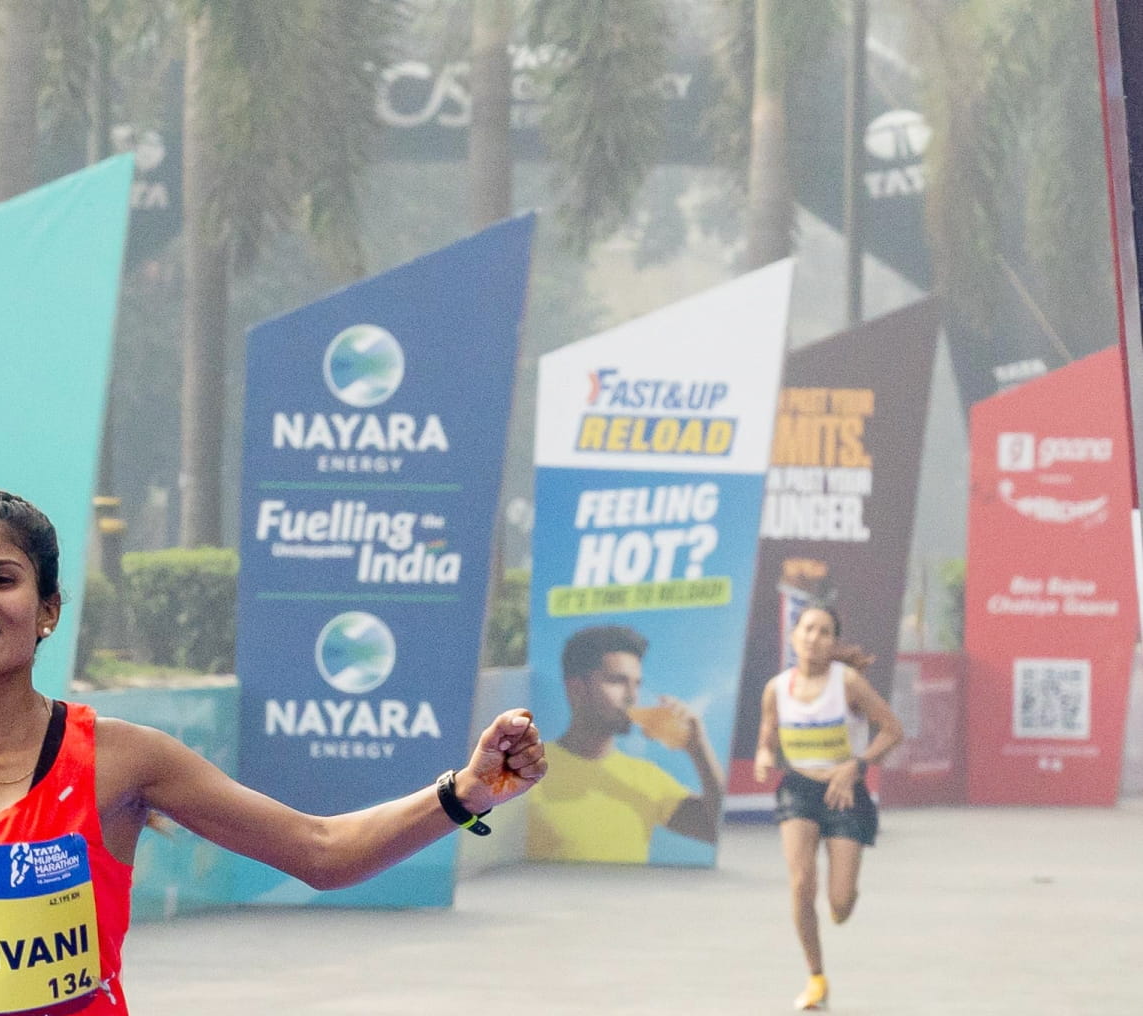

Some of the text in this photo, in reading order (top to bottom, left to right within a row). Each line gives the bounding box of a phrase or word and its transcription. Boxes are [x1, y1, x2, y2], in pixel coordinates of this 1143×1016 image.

[589, 369, 728, 409] FAST&UP
[273, 413, 449, 451] NAYARA
[578, 415, 733, 455] RELOAD
[317, 456, 403, 473] ENERGY
[575, 482, 719, 530] FEELING
[256, 500, 418, 551] Fuelling
[357, 545, 461, 584] India
[571, 524, 718, 588] HOT?
[265, 699, 441, 738] NAYARA
[310, 742, 395, 759] ENERGY
[32, 844, 61, 857] TATA
[33, 849, 68, 866] MUMBAI
[35, 854, 79, 874] MARATHON
[47, 967, 93, 999] 134
